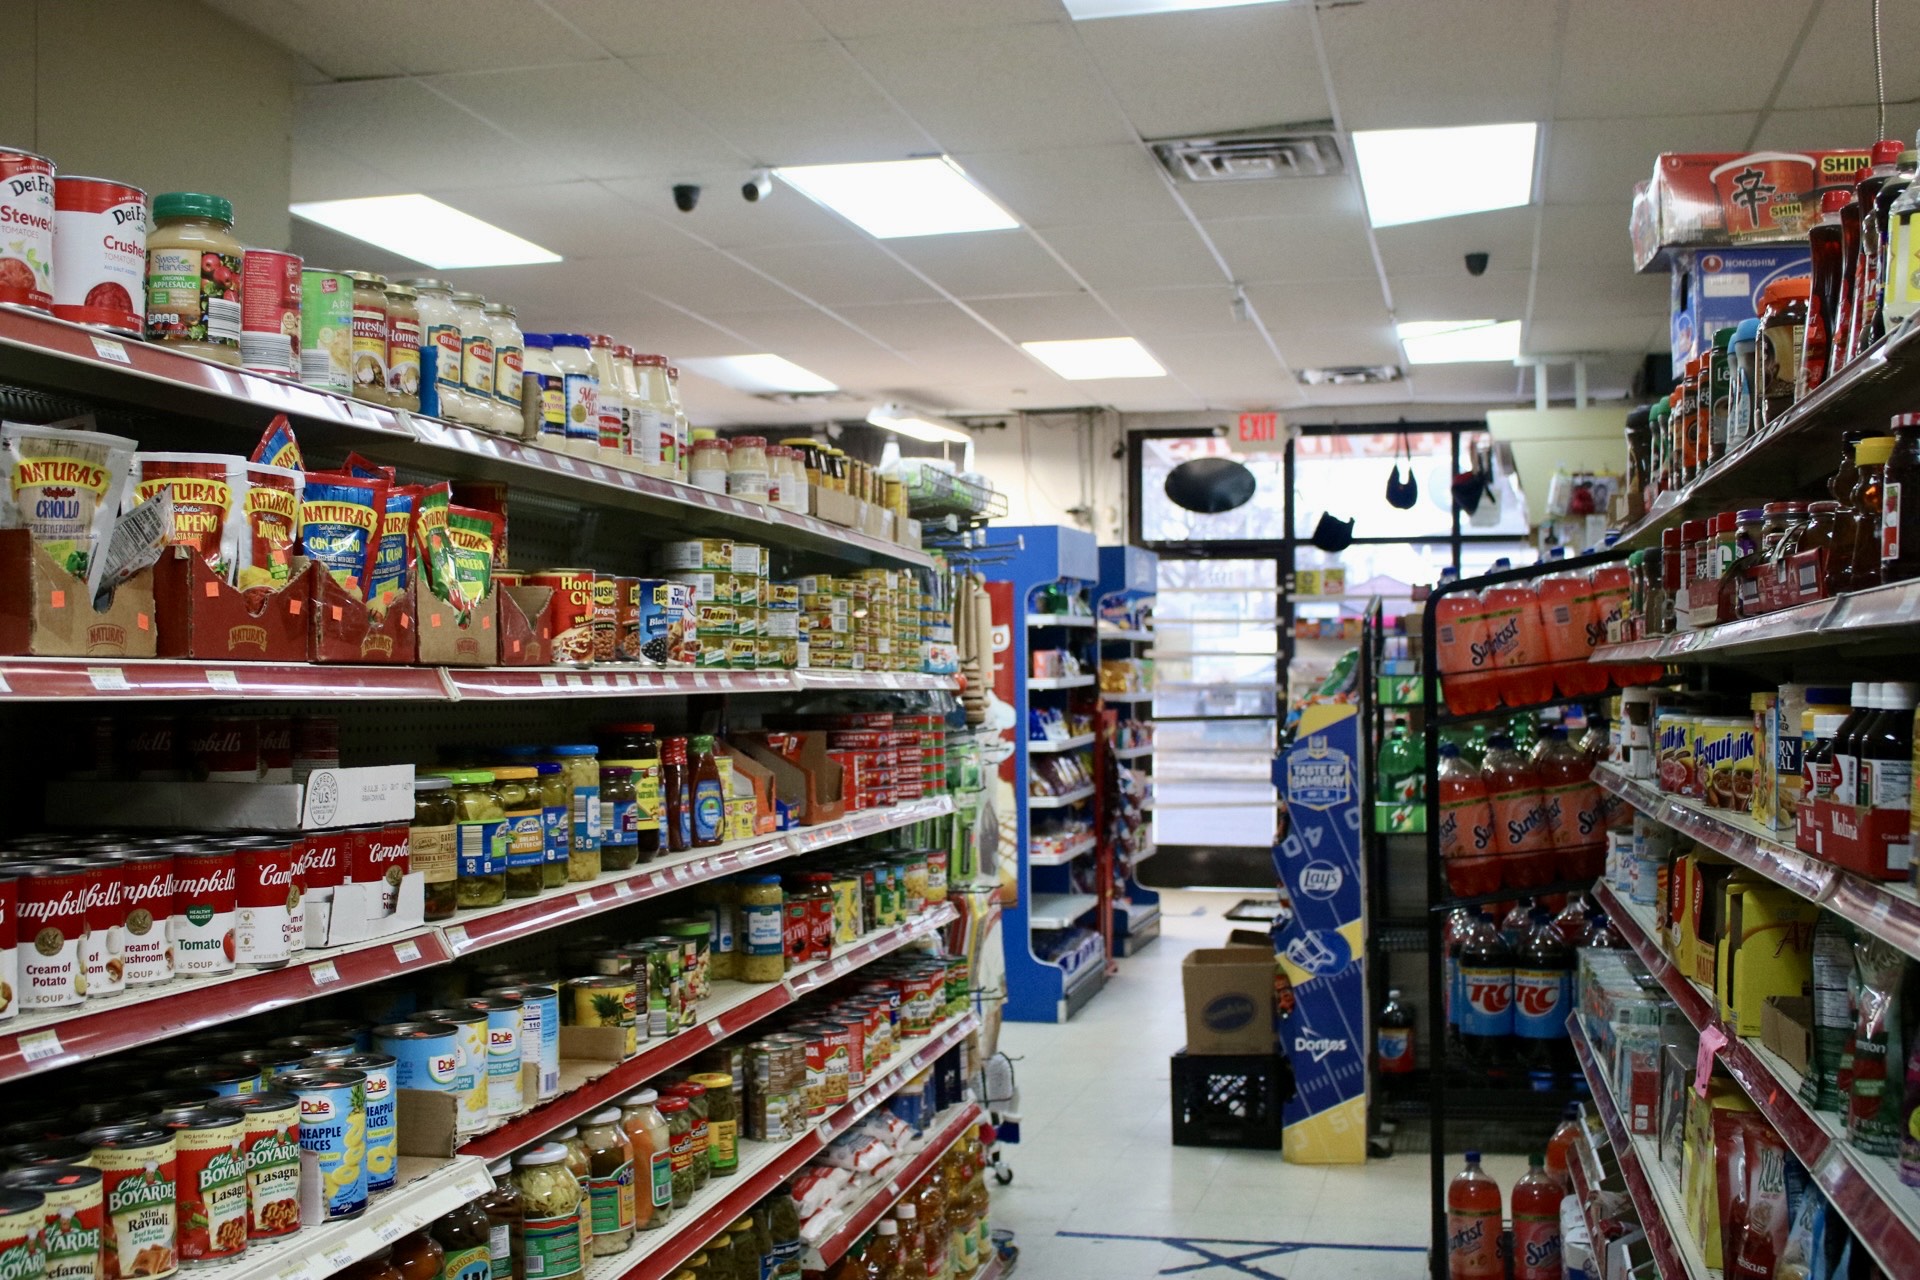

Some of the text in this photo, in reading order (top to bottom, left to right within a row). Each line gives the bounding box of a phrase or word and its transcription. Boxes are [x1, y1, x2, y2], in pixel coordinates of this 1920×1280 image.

[1822, 156, 1869, 173] SHIN
[1825, 174, 1855, 183] NOOD
[9, 176, 37, 197] Dei
[113, 207, 135, 226] Dei
[1770, 205, 1801, 218] SHIN
[1, 225, 39, 239] TOMATOES
[104, 252, 136, 266] TOMATOES
[155, 254, 181, 266] Sweet
[1725, 259, 1777, 268] NONGSHIM
[158, 262, 192, 273] Harvest
[153, 281, 197, 290] APPLESAUCE
[332, 300, 351, 309] APP
[354, 320, 387, 338] mestyl
[354, 330, 378, 339] GRAVY
[388, 330, 419, 344] Homes
[440, 335, 461, 349] BERTOL
[473, 346, 492, 360] BERTO
[1239, 413, 1277, 441] EXIT
[36, 499, 80, 519] CRIOLLO
[176, 511, 218, 533] APEÑO
[309, 536, 329, 550] CON
[561, 576, 593, 591] Hor
[571, 591, 592, 606] Chi
[594, 586, 614, 598] BUSH
[655, 589, 668, 601] BUS
[593, 606, 615, 616] rigin
[732, 642, 754, 652] lores
[1470, 617, 1520, 667] Sunkist
[1704, 732, 1732, 769] squi
[1779, 740, 1795, 755] RN
[1293, 765, 1344, 777] TASTE OF
[1779, 761, 1795, 771] EAL
[1292, 775, 1345, 788] GAMEDAY
[1817, 770, 1832, 784] olin
[318, 791, 330, 804] U.S.
[1831, 810, 1858, 841] Molina
[182, 858, 224, 867] NDENSED
[305, 847, 336, 868] bell's
[123, 863, 162, 871] NDENSED
[31, 878, 75, 886] NDENSED
[173, 867, 236, 898] ampbell's
[1304, 869, 1338, 892] Lay's
[87, 880, 121, 907] bell's
[124, 872, 174, 905] mpbell's
[1693, 879, 1701, 914] Atole
[17, 887, 87, 923] ampbell'
[189, 908, 211, 916] HEALTHY
[189, 913, 212, 921] REQUEST
[125, 941, 160, 953] ream of
[178, 938, 221, 952] Tomato
[89, 951, 99, 962] of
[125, 953, 163, 966] ushroom
[26, 962, 71, 976] Cream of
[188, 960, 213, 970] SOUP
[32, 975, 67, 988] Potato
[127, 969, 154, 980] SOUP
[36, 993, 64, 1004] SOUP
[1515, 983, 1559, 1016] RC
[491, 1032, 513, 1043] Dole
[1295, 1037, 1347, 1052] Doritos
[438, 1058, 455, 1071] Dole
[367, 1079, 387, 1091] Dole
[458, 1077, 472, 1085] APPLE
[301, 1101, 330, 1113] Dole
[367, 1101, 393, 1118] EAPPLE
[300, 1126, 342, 1141] NEAPPLE
[252, 1136, 275, 1153] Chef
[208, 1152, 229, 1170] Chef
[199, 1158, 246, 1188] BOYARD
[255, 1167, 298, 1187] Lasagna
[117, 1174, 143, 1193] Chef
[108, 1180, 176, 1212] BOYARDEE
[211, 1183, 246, 1205] Lasagn
[139, 1209, 159, 1221] Mini
[127, 1212, 170, 1233] Ravioli
[46, 1228, 100, 1253] YARDEE
[1450, 1219, 1483, 1250] nkist
[1525, 1234, 1561, 1267] Sunk
[2, 1253, 46, 1280] OYARD
[49, 1262, 94, 1279] efaroni
[1738, 1258, 1768, 1276] ibiscus
